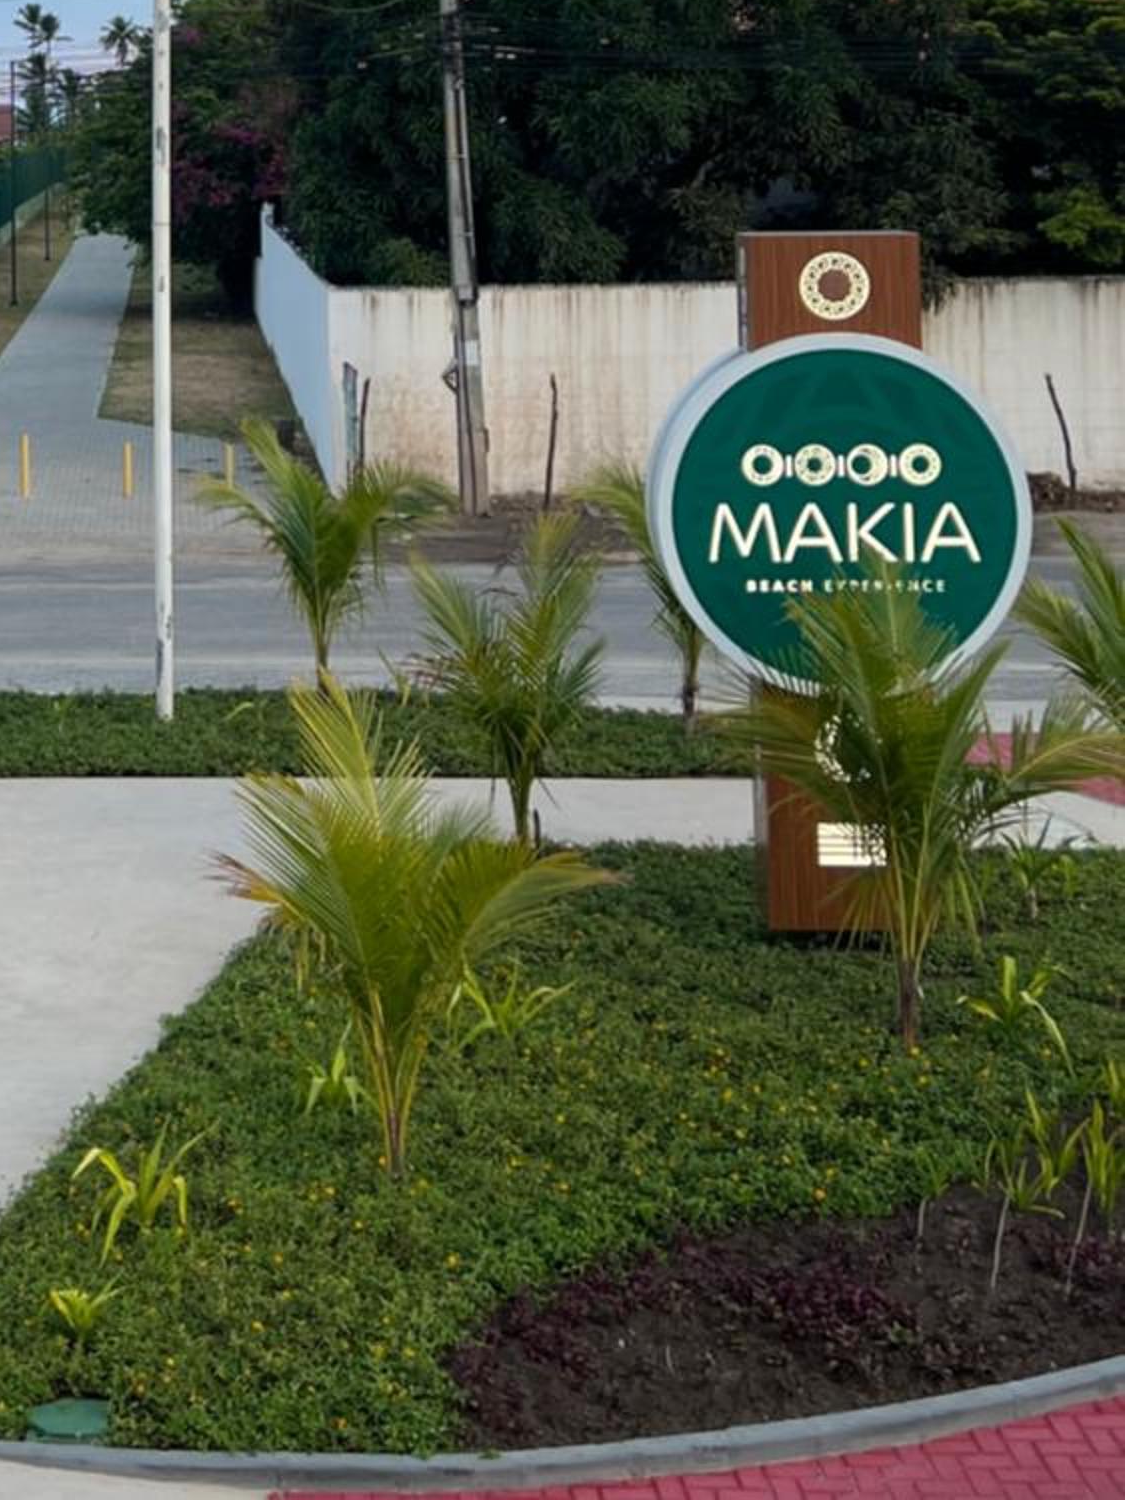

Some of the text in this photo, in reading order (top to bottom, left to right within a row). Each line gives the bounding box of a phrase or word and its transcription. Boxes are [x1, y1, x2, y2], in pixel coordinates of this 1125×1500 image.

[708, 501, 982, 564] MAKIA
[744, 578, 946, 594] BEACH EXPERENCE
